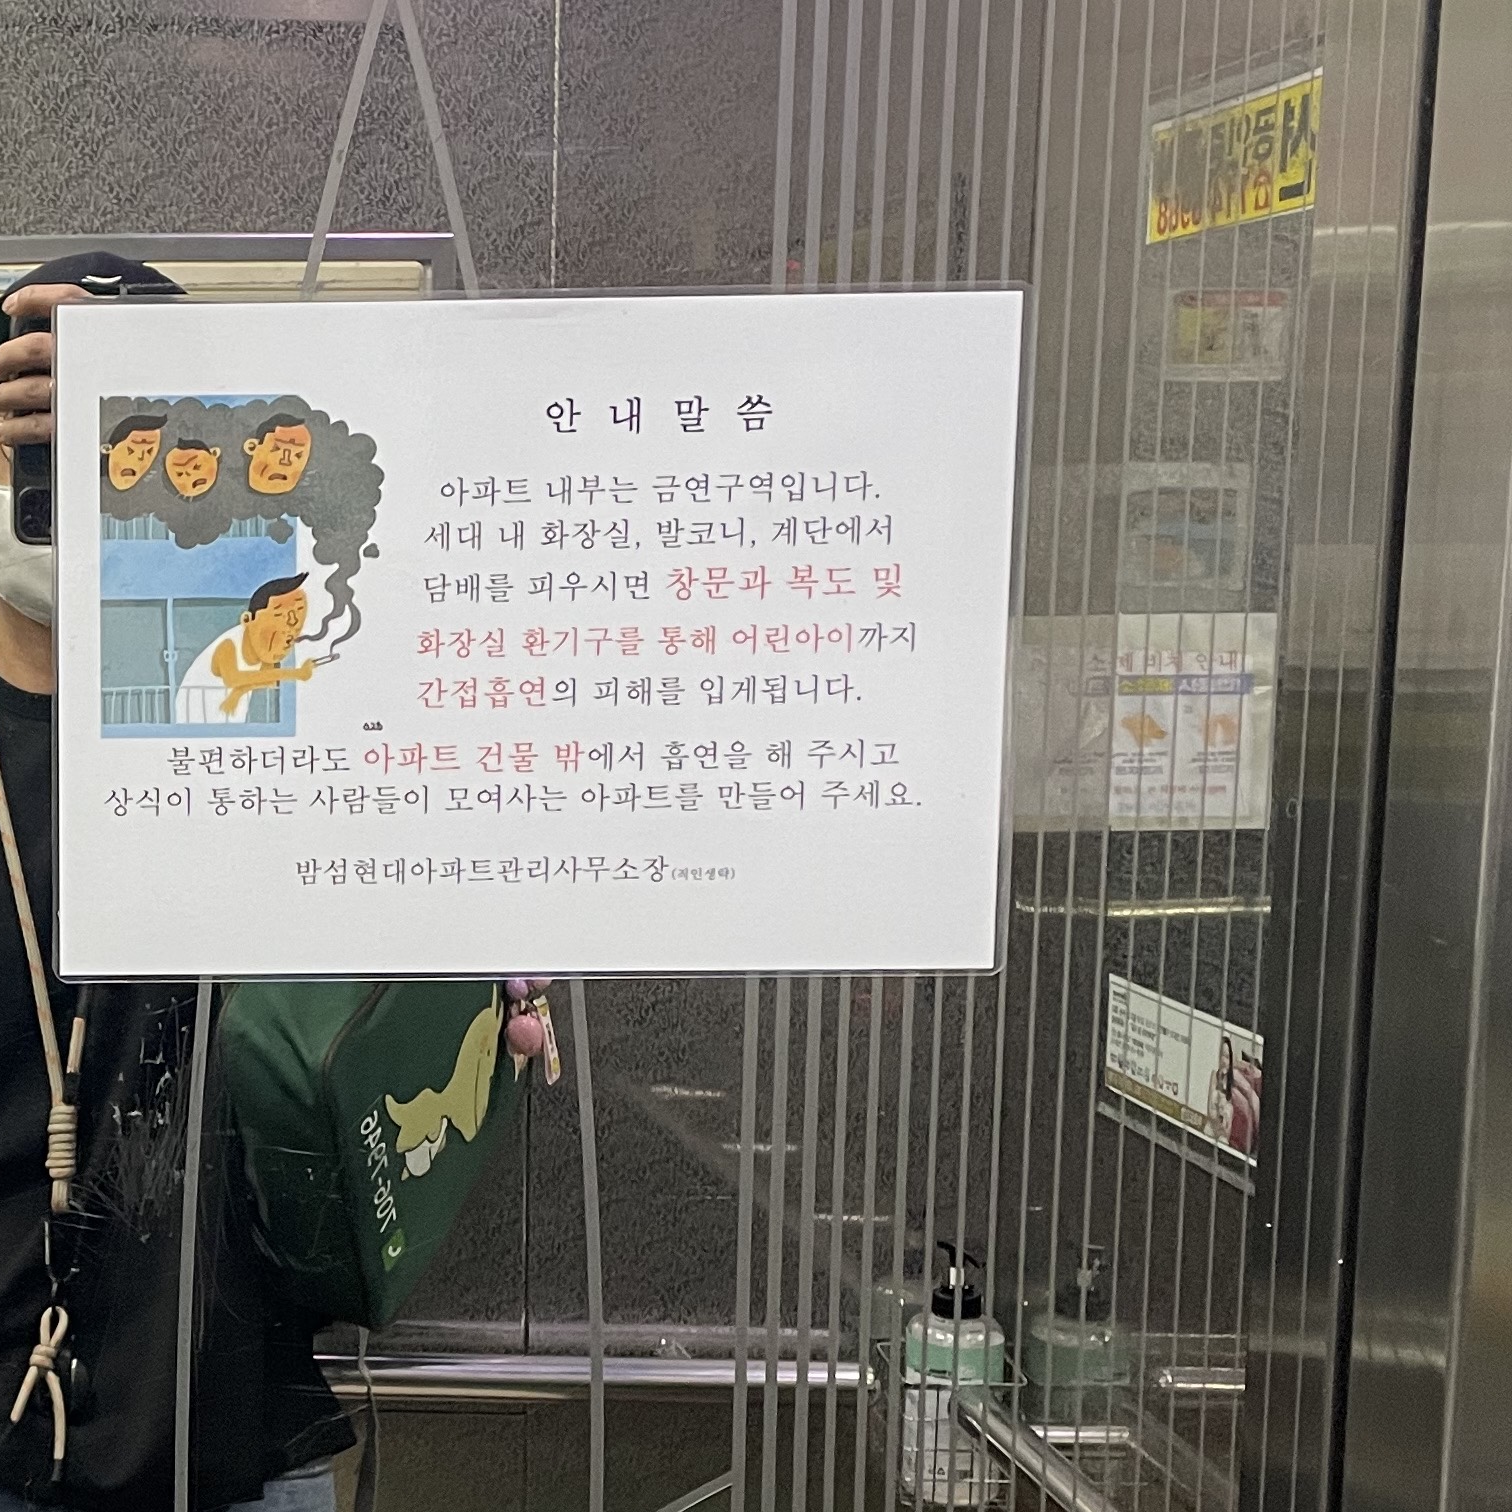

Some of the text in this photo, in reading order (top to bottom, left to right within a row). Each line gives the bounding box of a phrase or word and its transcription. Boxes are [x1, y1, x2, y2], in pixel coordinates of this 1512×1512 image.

[441, 471, 879, 507] 아파트 내부는 금연구역입니다.
[424, 515, 891, 552] 세대 내 화장실, 발코니, 계단에서
[424, 563, 901, 603] 담배를 피우시면 창문과 복도 및
[417, 622, 915, 658] 화장실 환기구를 통해 어린아이까지
[417, 674, 861, 709] 간접흡연의 피해를 입게됩니다.
[166, 739, 899, 775] 불편하더라도 아파트 건물 밖에서 흡연을 해 주시고
[104, 780, 921, 816] 상식이 통하는 사람들이 모여사는 아파트를 만들어 주세요.
